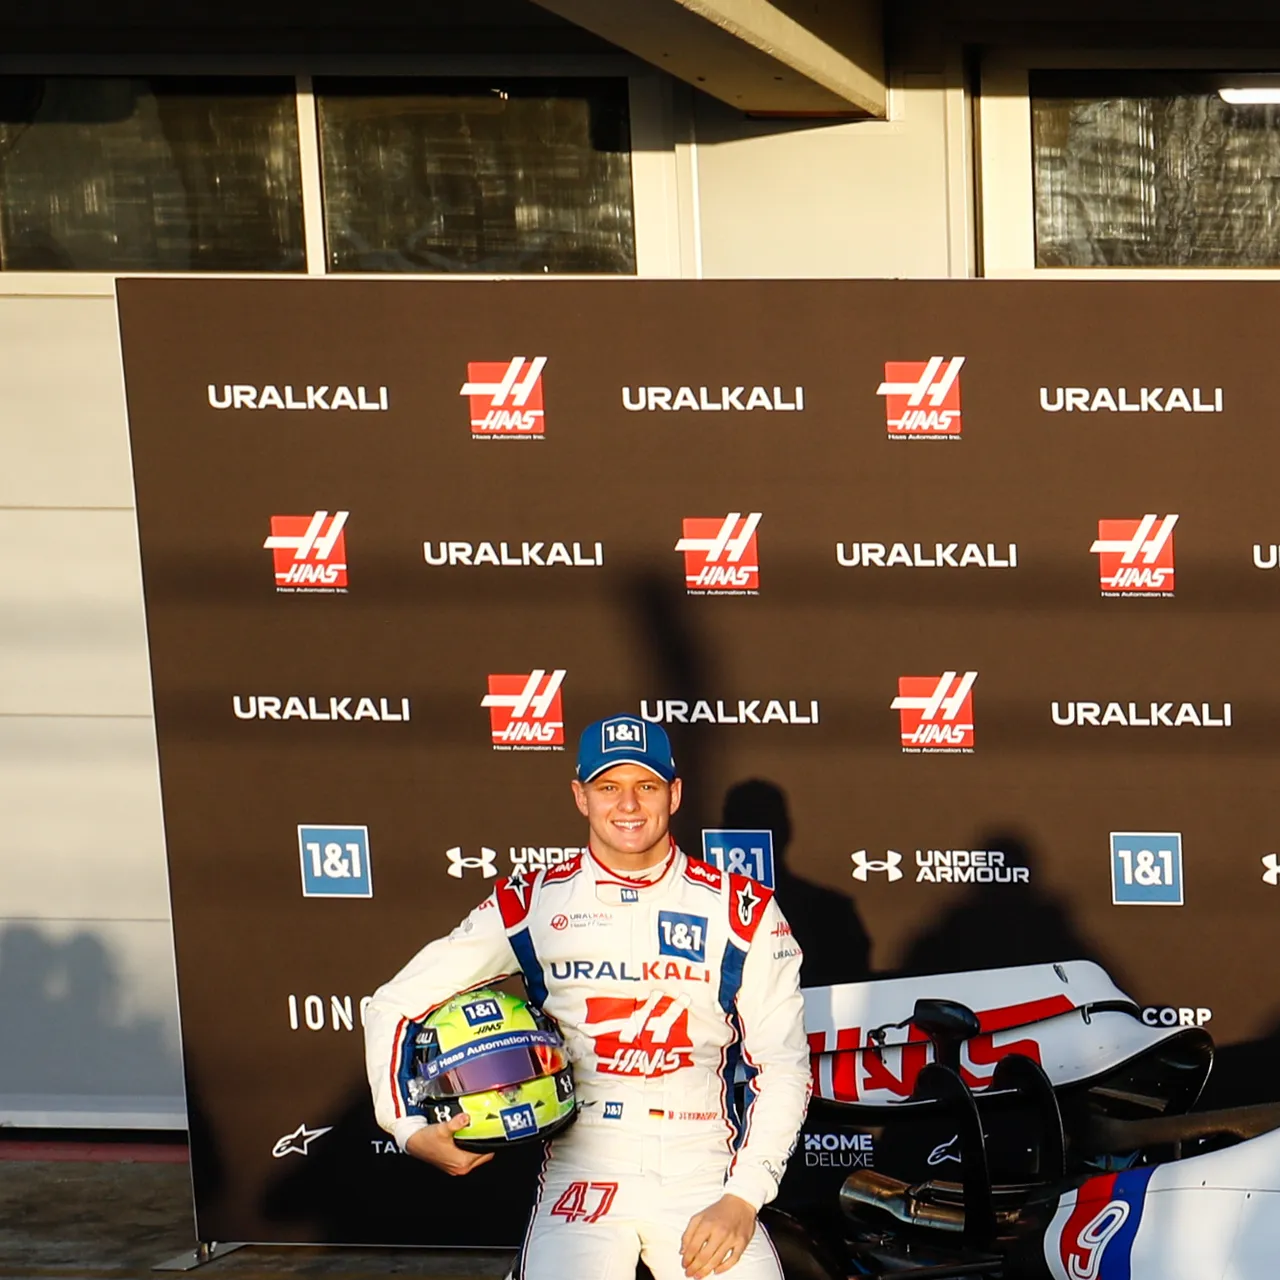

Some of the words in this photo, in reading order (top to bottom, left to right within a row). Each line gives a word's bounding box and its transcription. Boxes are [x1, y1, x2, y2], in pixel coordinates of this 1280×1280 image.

[208, 385, 388, 410] URALKALI
[622, 387, 804, 411] URALKALI
[1040, 388, 1223, 412] URALKALI
[471, 410, 544, 429] HAAS
[887, 410, 960, 430] HAAS
[424, 542, 603, 566] URALKALI
[837, 543, 1017, 567] URALKALI
[276, 563, 347, 583] HAAS
[686, 566, 758, 585] HAAS
[1101, 568, 1174, 588] HAAS
[233, 696, 410, 721] URALKALI
[640, 700, 818, 723] URALKALI
[1051, 702, 1232, 727] URALKALI
[492, 721, 564, 741] HAAS
[606, 721, 640, 742] 1&1
[902, 723, 974, 743] HAAS
[304, 842, 362, 879] 1&1
[509, 847, 590, 863] UNDE
[916, 850, 1005, 867] UNDER
[915, 867, 1030, 883] ARMOUR
[1119, 849, 1173, 886] 1&1
[622, 890, 638, 902] 1&1
[661, 921, 702, 951] 1&1
[551, 960, 711, 983] URALKALI
[465, 1002, 498, 1020] 1&1
[439, 1053, 465, 1068] Haas
[466, 1032, 530, 1056] Automation
[531, 1034, 547, 1043] Inc.
[597, 1049, 694, 1074] HAAS
[503, 1110, 534, 1131] 1&1
[804, 1134, 874, 1151] HOME
[805, 1152, 874, 1167] DELUXE
[551, 1181, 619, 1223] 47
